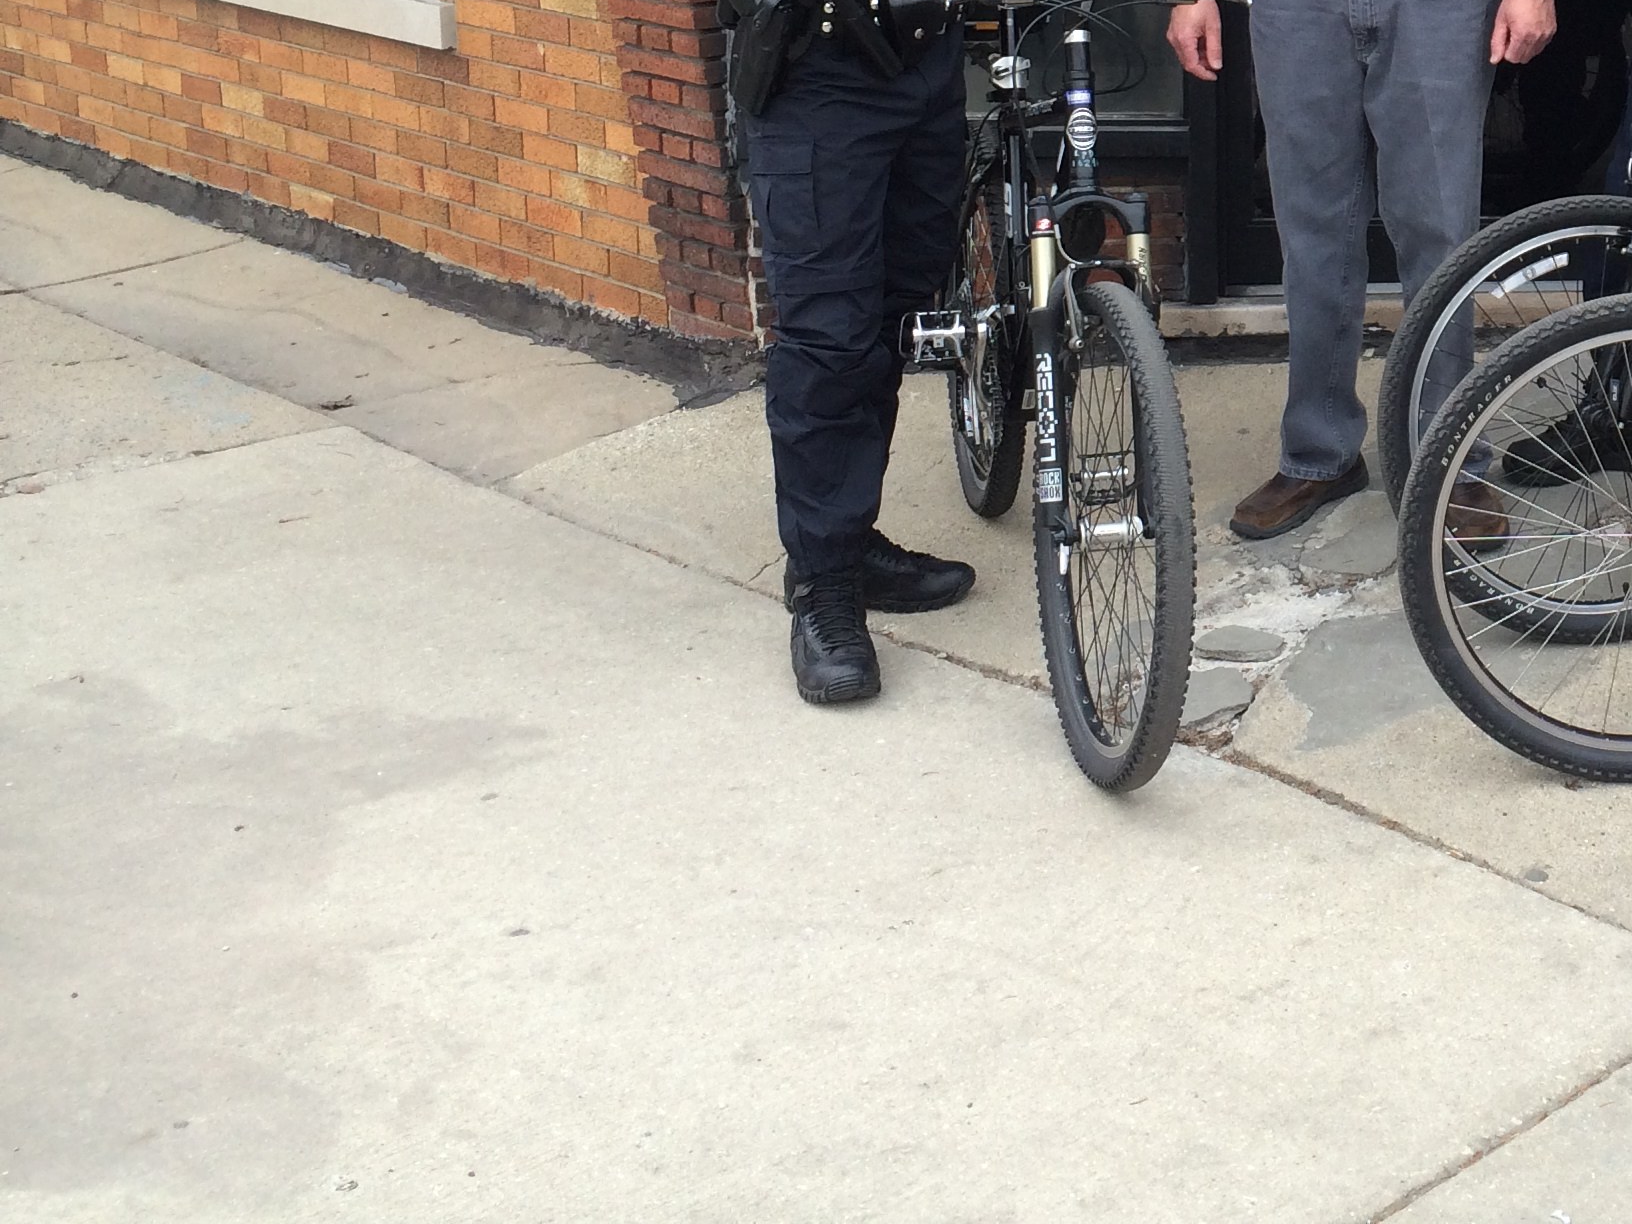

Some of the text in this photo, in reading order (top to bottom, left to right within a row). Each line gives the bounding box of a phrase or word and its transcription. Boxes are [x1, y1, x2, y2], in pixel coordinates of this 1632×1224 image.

[1440, 374, 1512, 467] BONTRAGER
[1040, 470, 1061, 486] ROCK
[1040, 485, 1062, 501] SHOX
